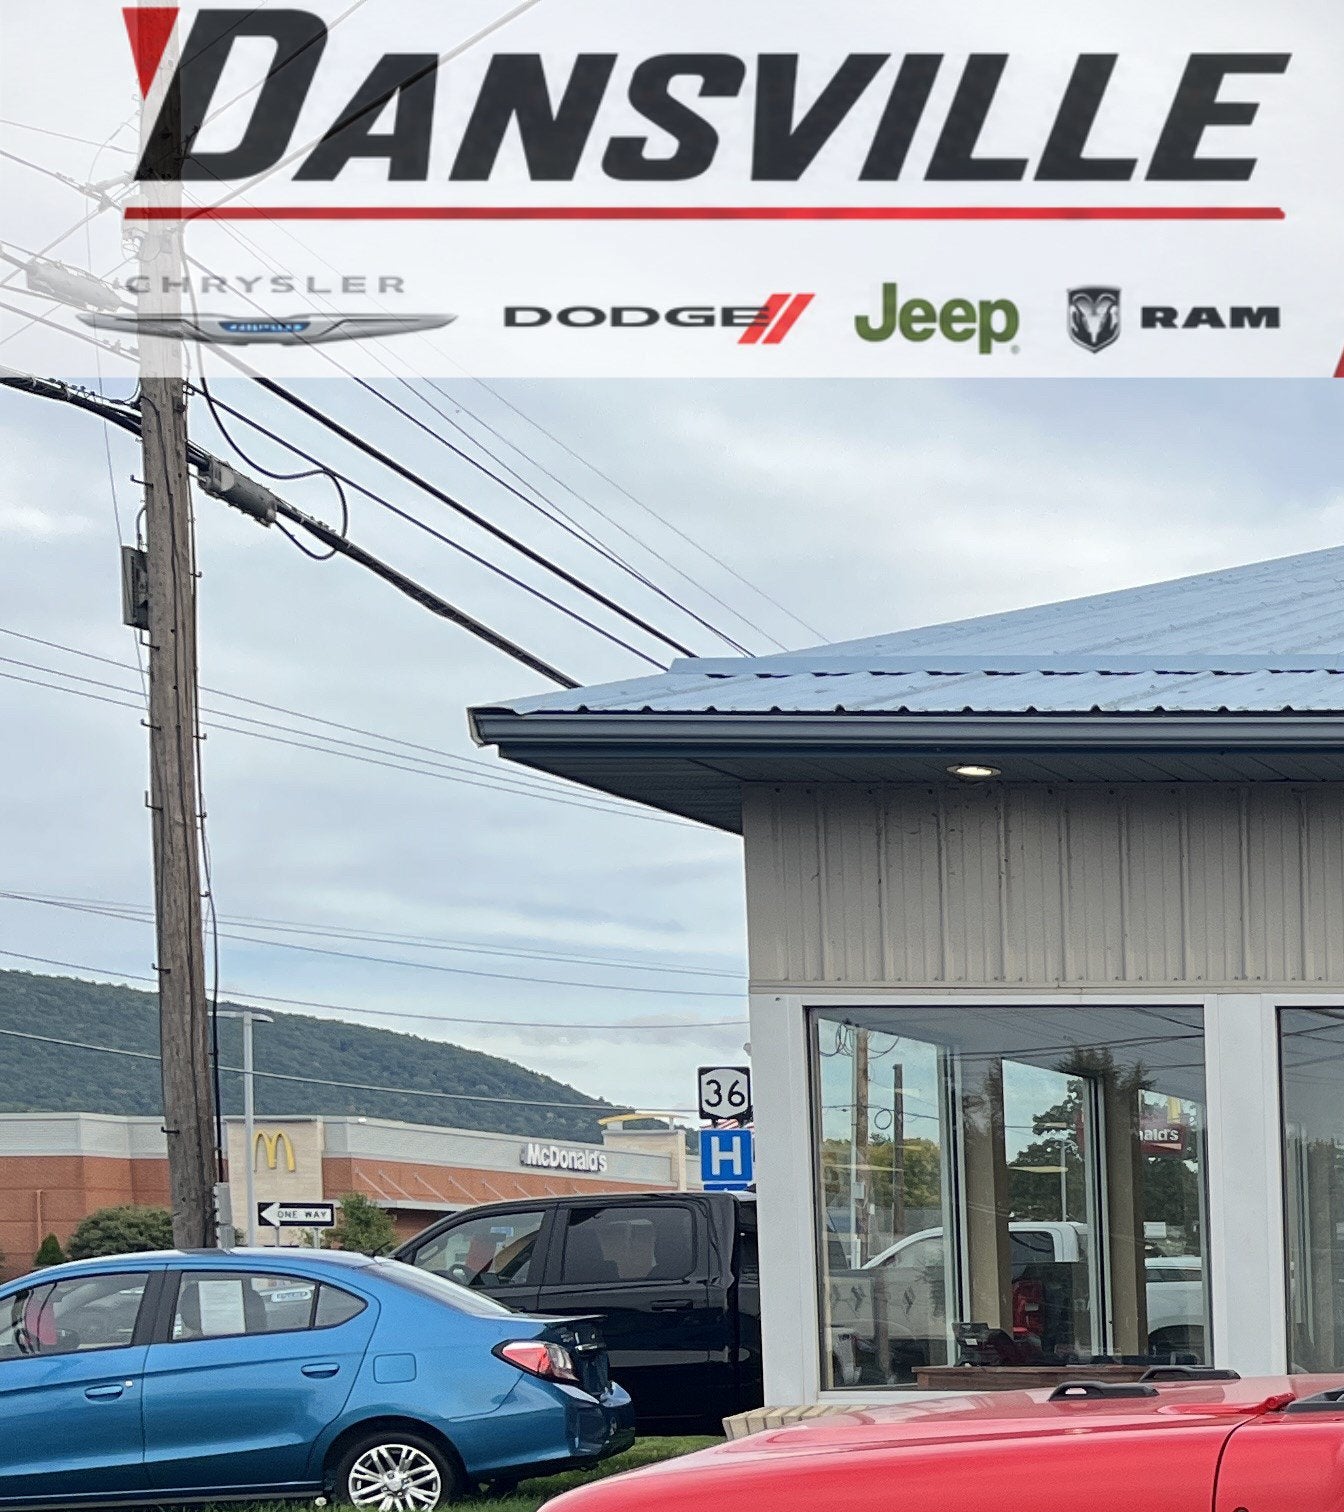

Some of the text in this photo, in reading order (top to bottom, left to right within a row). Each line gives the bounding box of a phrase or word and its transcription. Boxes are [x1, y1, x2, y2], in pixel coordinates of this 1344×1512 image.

[705, 1079, 746, 1108] 36
[526, 1143, 607, 1172] McDonald's
[711, 1136, 742, 1176] H
[277, 1210, 327, 1219] ONE WAY
